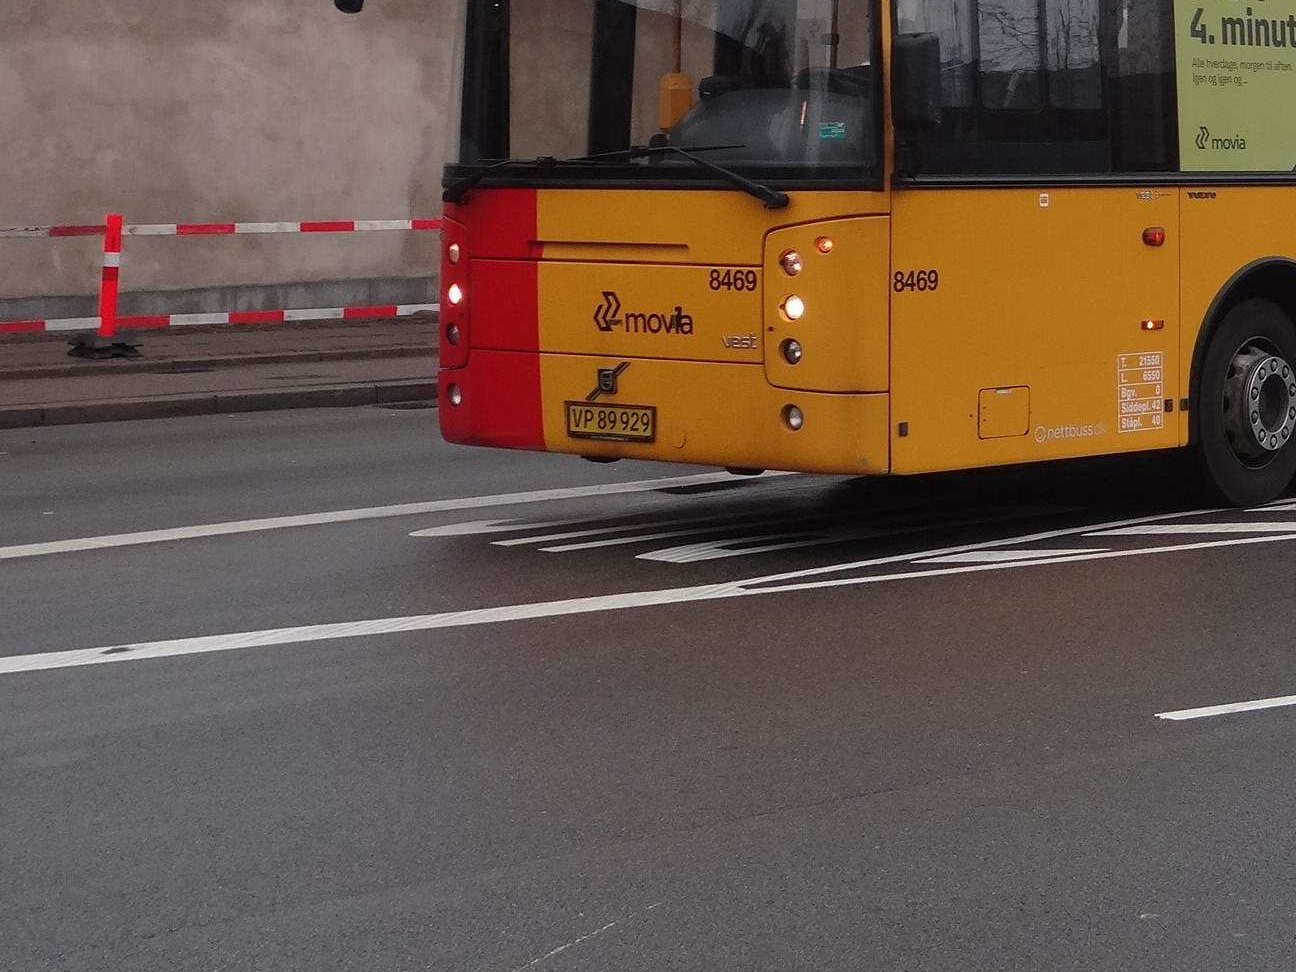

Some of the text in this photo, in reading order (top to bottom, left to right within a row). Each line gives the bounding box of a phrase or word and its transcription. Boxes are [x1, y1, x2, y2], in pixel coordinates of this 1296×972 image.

[1190, 8, 1215, 44] 4.
[1192, 57, 1205, 68] Alle
[1206, 59, 1238, 72] hverdage,
[1240, 61, 1265, 73] morgen
[1193, 73, 1207, 85] Igen
[1208, 75, 1217, 86] og
[1218, 74, 1232, 86] igen
[1211, 133, 1246, 150] movia
[709, 269, 757, 291] 8469
[893, 269, 939, 293] 8469
[722, 331, 758, 349] vest
[1120, 355, 1160, 367] T. 21550
[1142, 370, 1160, 381] 6550
[1155, 385, 1160, 395] 0
[1151, 400, 1160, 410] 42
[572, 408, 650, 433] VP 89 929
[1151, 415, 1160, 425] 40
